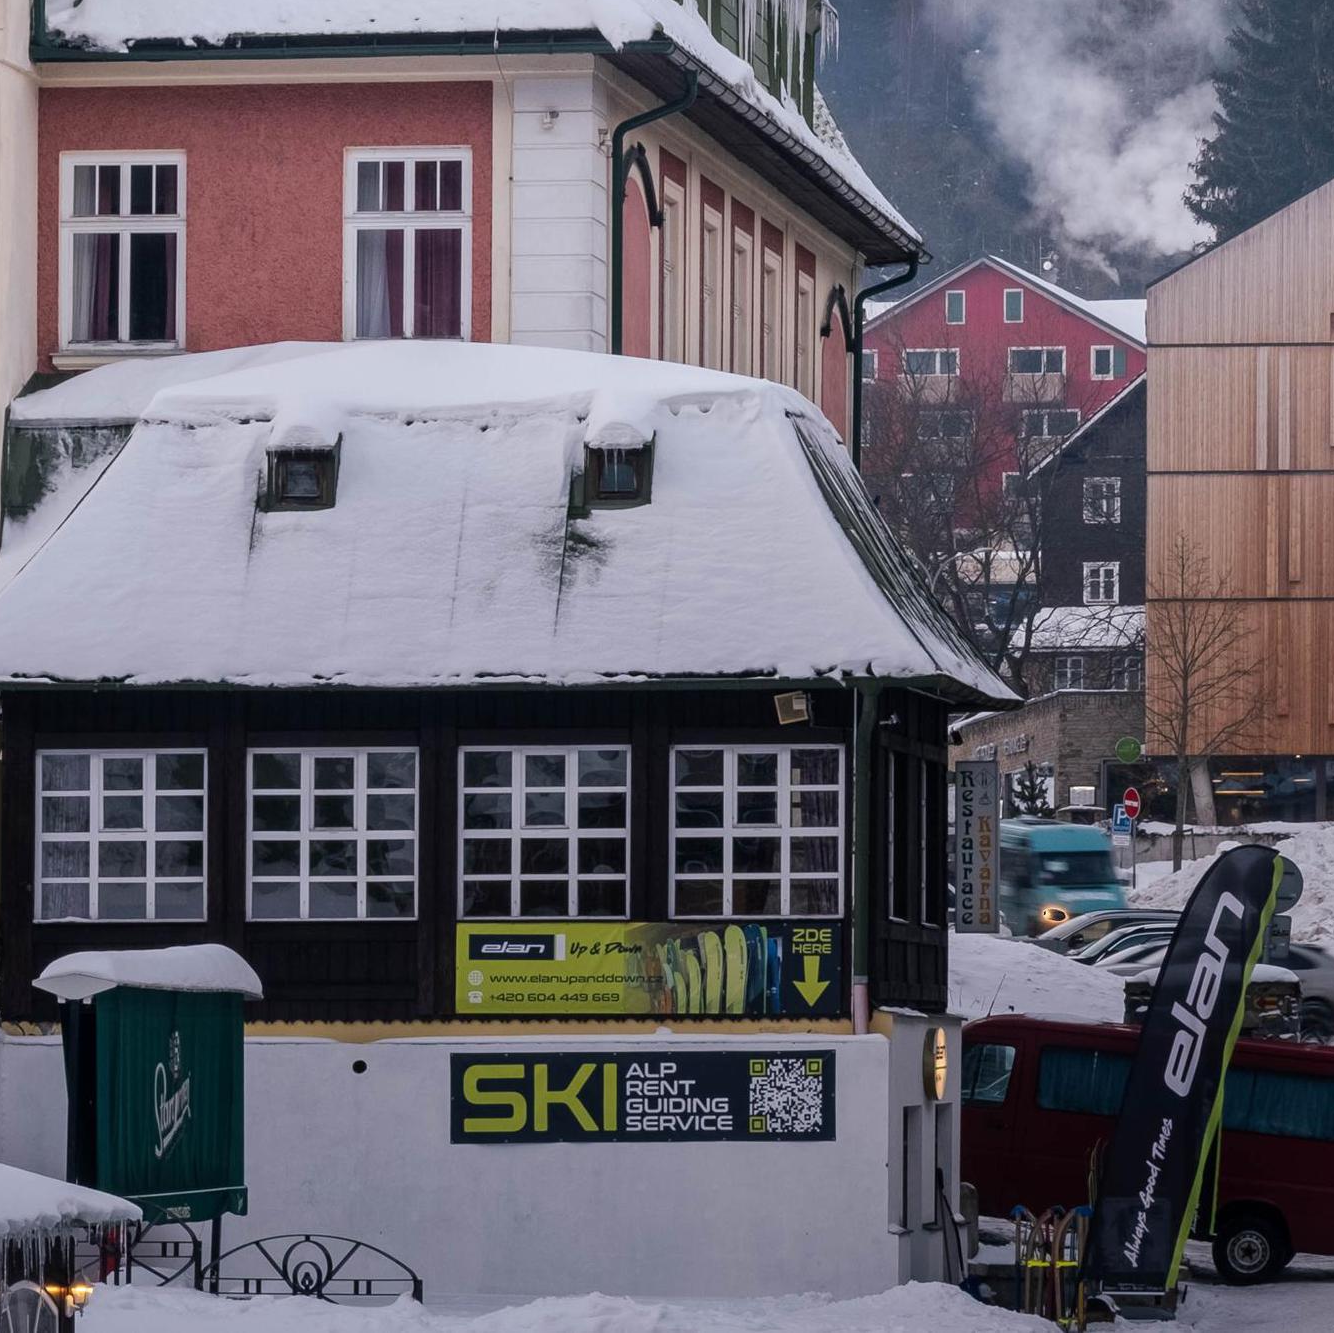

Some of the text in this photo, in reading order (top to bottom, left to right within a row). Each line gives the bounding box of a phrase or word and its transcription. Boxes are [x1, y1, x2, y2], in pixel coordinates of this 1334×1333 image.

[1117, 808, 1128, 825] P
[961, 771, 975, 925] Restaurace
[978, 816, 992, 924] Kavárna
[792, 928, 832, 942] ZDE
[481, 941, 643, 958] elan Up & Down
[792, 943, 832, 954] HERE
[489, 973, 664, 984] www.elanupanddown.cz
[490, 992, 620, 1002] +420 604 449 669
[1164, 891, 1245, 1097] elan
[626, 1062, 677, 1079] ALP
[626, 1080, 696, 1096] RENT
[463, 1063, 617, 1133] SKI
[626, 1097, 729, 1114] GUIDING
[626, 1115, 733, 1131] SERVICE
[1123, 1211, 1150, 1268] Always
[1138, 1160, 1162, 1209] Good
